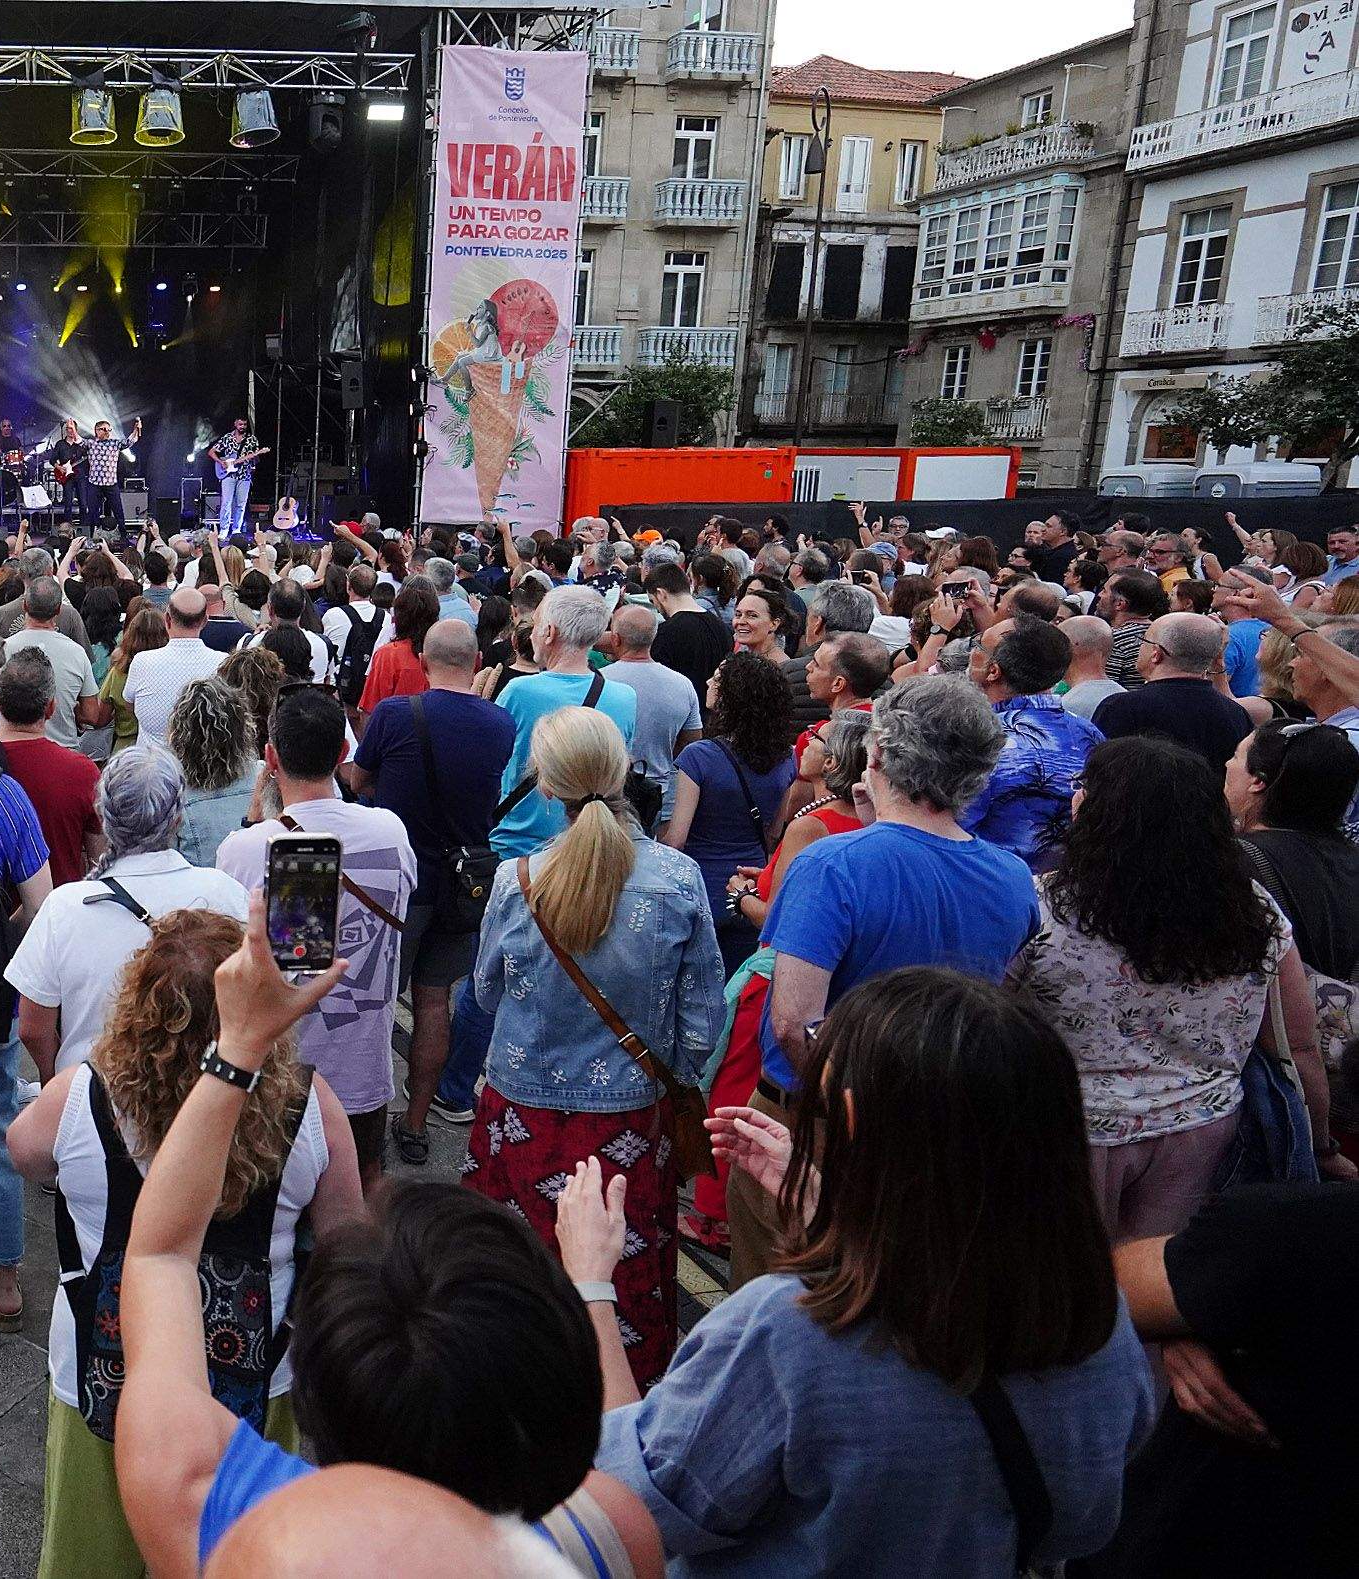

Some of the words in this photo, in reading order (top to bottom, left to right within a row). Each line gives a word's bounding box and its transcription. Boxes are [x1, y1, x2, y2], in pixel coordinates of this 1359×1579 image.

[498, 106, 529, 114] Concello
[498, 114, 538, 122] Pontevedra
[447, 132, 576, 201] VERÁN
[449, 205, 476, 221] UN
[477, 206, 542, 223] TEMPO
[447, 224, 501, 239] PARA
[504, 226, 569, 242] GOZAR
[445, 245, 535, 258] PONTEVEDRA
[536, 249, 568, 260] 2025
